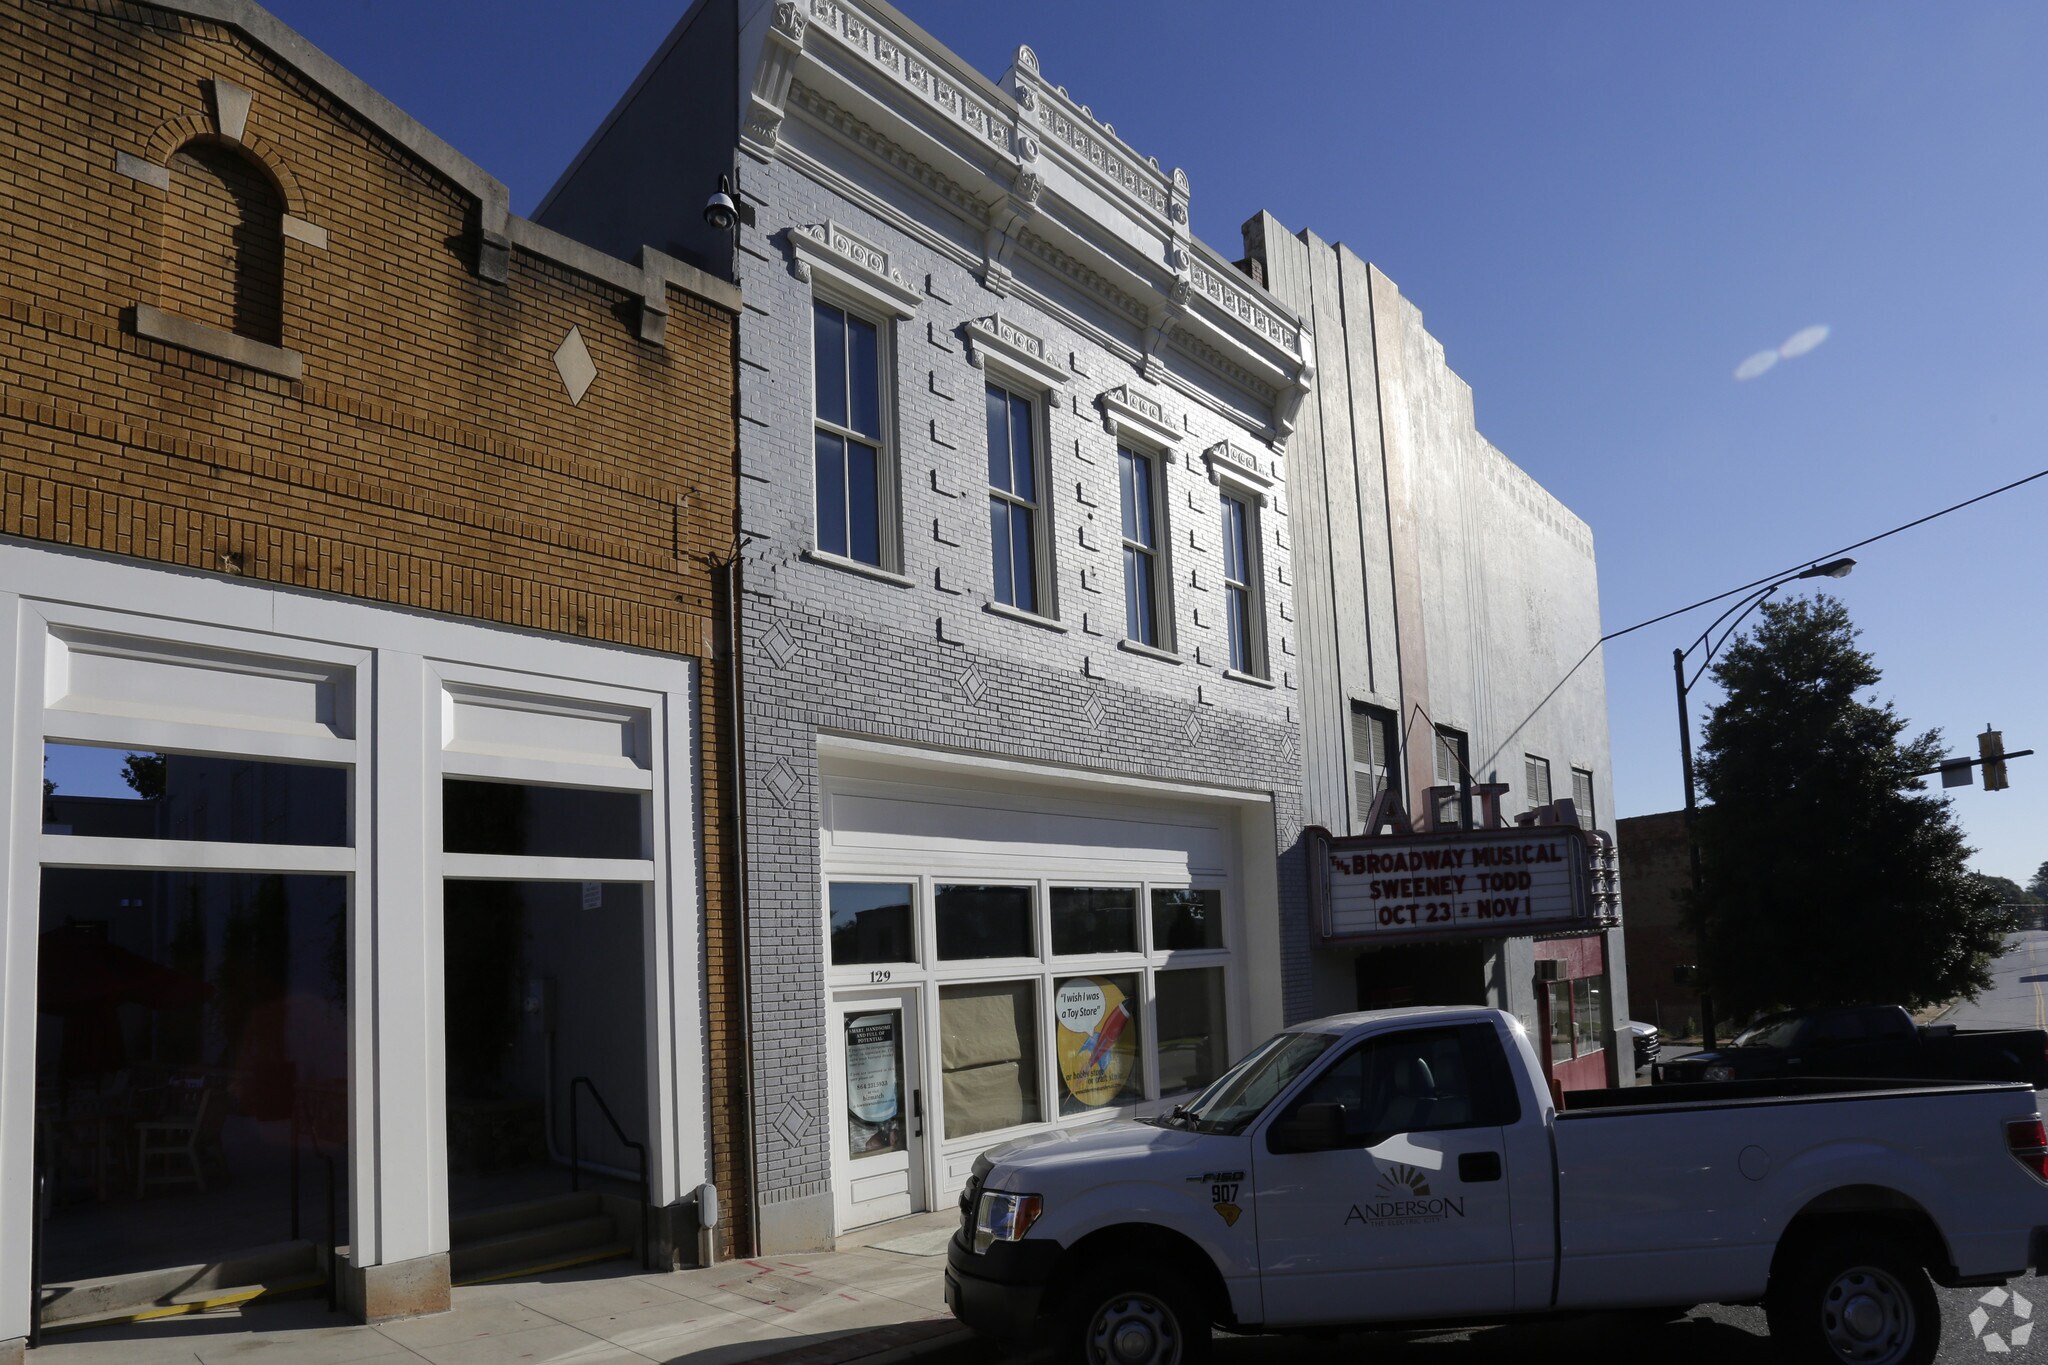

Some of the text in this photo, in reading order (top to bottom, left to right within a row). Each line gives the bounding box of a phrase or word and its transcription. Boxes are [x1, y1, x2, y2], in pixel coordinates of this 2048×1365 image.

[1353, 848, 1466, 875] BROADWAY
[1472, 843, 1562, 868] MUSICAL
[1369, 871, 1531, 900] SWEENEY TODD
[1379, 904, 1419, 926] OCT
[1426, 902, 1451, 923] 23
[1477, 897, 1520, 920] NOV
[870, 970, 891, 983] 129
[1067, 992, 1082, 1003] wish
[1086, 993, 1099, 1001] was
[1067, 1008, 1079, 1020] Toy
[1212, 1184, 1239, 1203] 907
[1344, 1196, 1464, 1226] ANDERSON
[1371, 1216, 1440, 1228] THE ELECTRIC CITY
